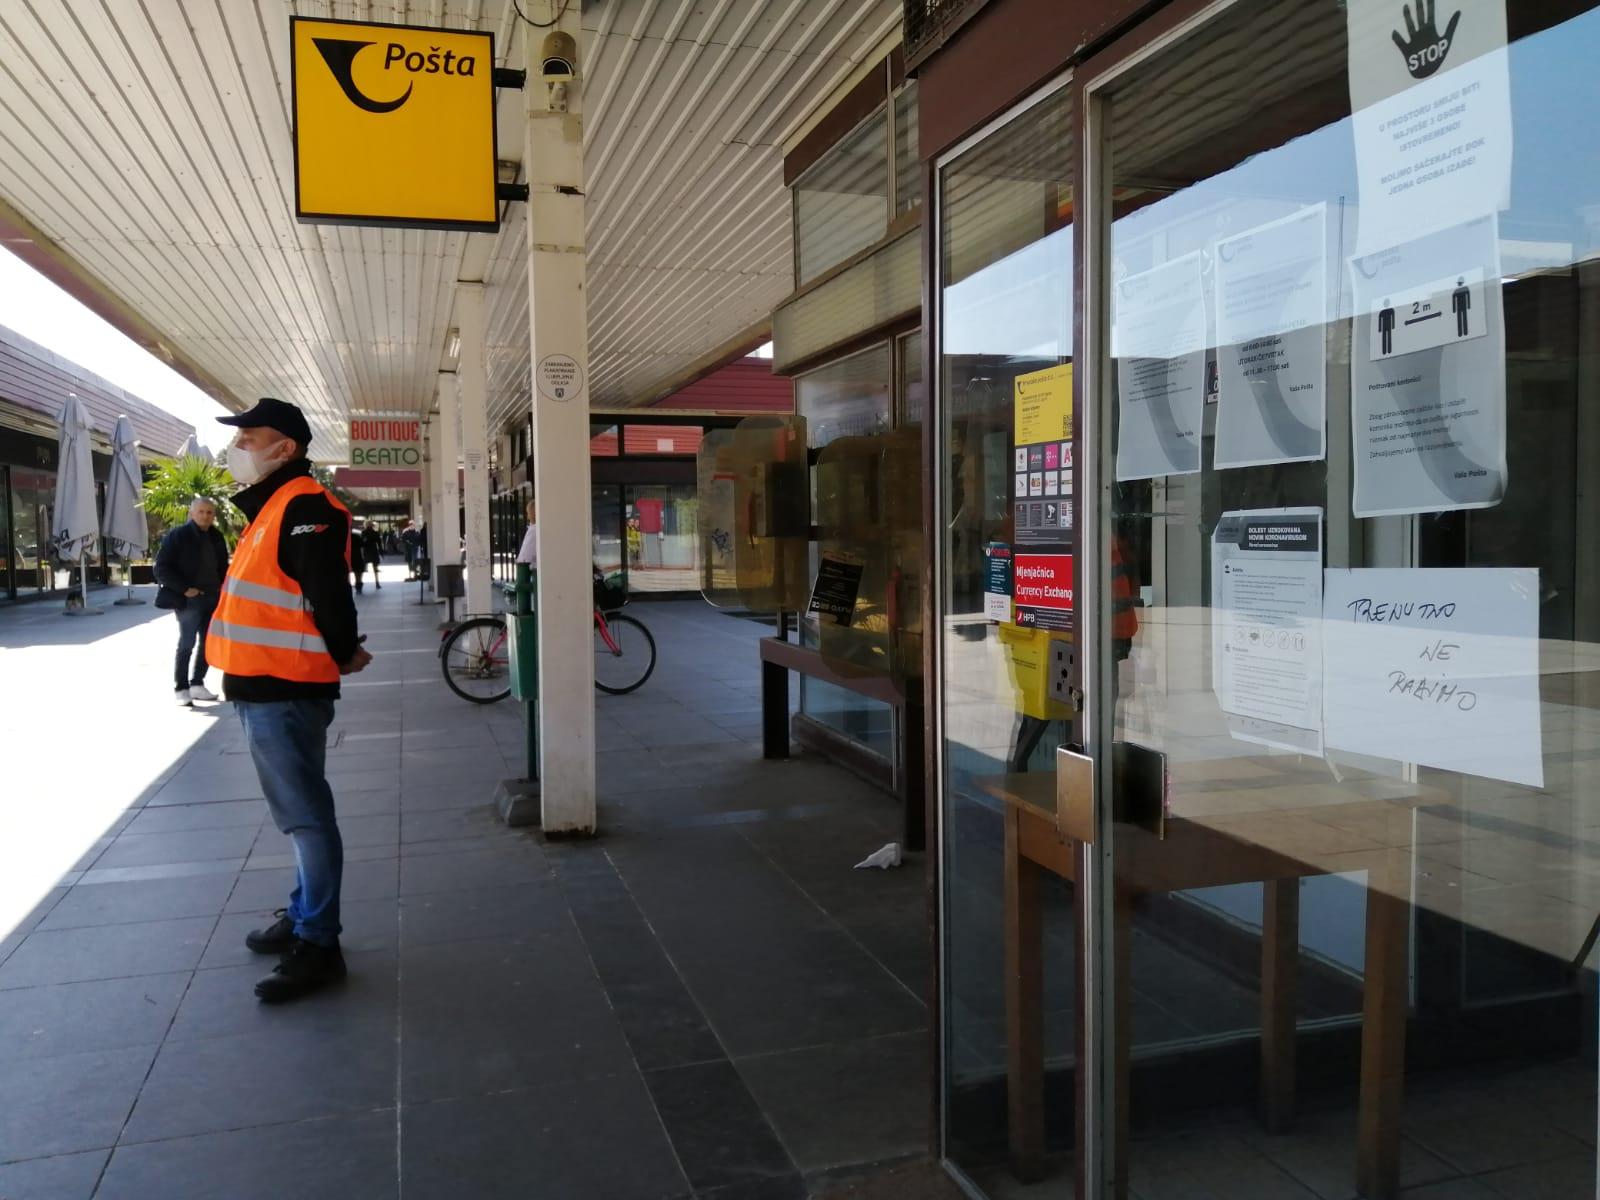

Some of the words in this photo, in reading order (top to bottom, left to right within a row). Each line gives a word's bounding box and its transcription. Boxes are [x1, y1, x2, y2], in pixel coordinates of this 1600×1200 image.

[384, 43, 475, 76] Pošta
[1408, 38, 1449, 71] STOP
[1378, 123, 1385, 133] U
[1386, 103, 1432, 129] PROSTORU
[1380, 166, 1412, 184] MOLIMO
[1416, 168, 1445, 185] OSOBA
[1412, 301, 1420, 314] 2
[1422, 303, 1431, 312] m
[352, 420, 419, 442] BOUTIQUE
[352, 448, 419, 465] BEATO
[1016, 565, 1054, 579] Mjenjačnica
[1016, 584, 1042, 599] Currency
[1044, 585, 1072, 600] Exchang
[1023, 613, 1035, 622] HPB
[1420, 640, 1460, 661] NE
